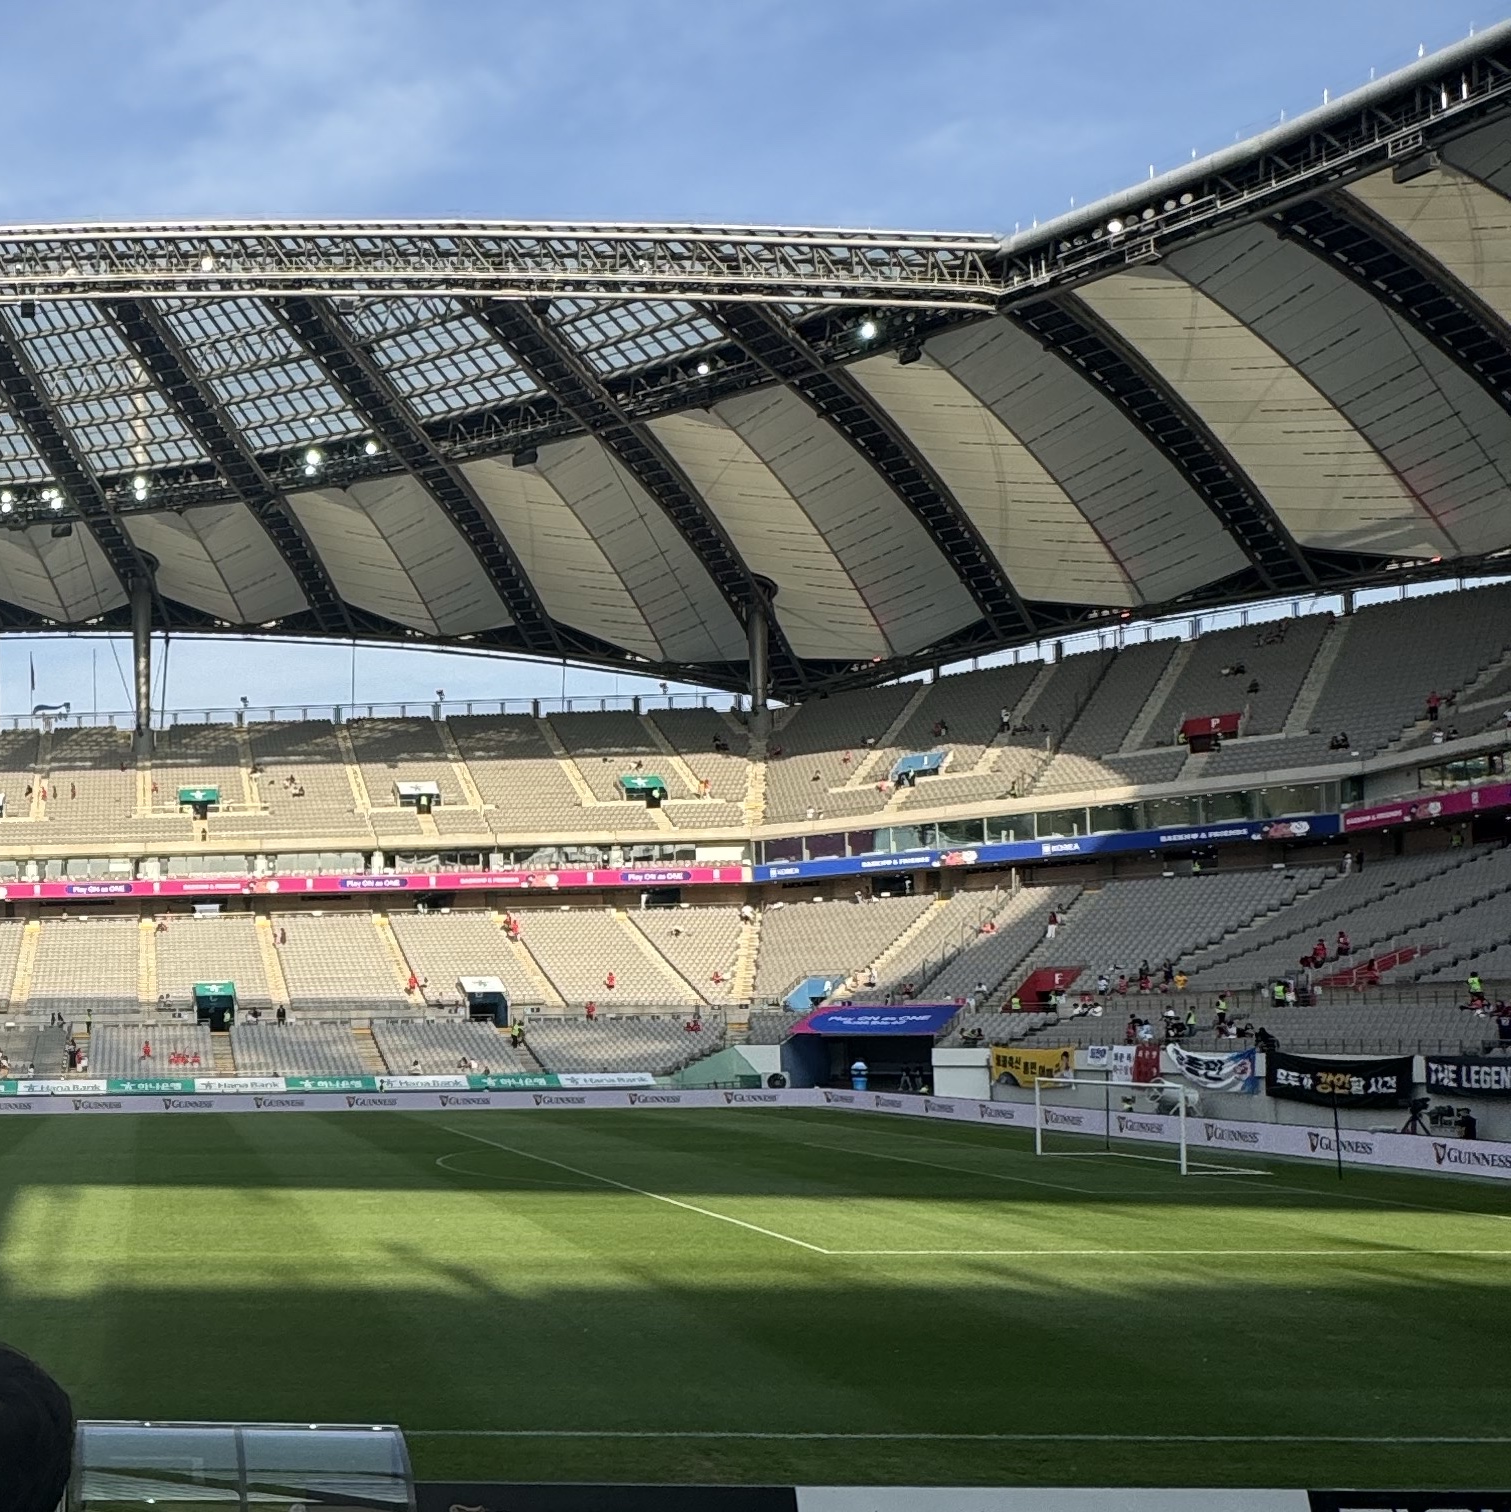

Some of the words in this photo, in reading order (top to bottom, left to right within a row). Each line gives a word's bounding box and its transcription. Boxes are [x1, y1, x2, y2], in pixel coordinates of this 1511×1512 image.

[1054, 973, 1063, 984] F
[1429, 1062, 1458, 1087] THE
[218, 1081, 249, 1090] Hana
[251, 1081, 279, 1089] Bank
[433, 1079, 462, 1088] Bank
[1276, 1068, 1313, 1090] 모두가
[1315, 1071, 1365, 1095] 강인할
[1367, 1075, 1397, 1094] 사건
[355, 1098, 398, 1107] GUINNESS
[448, 1097, 491, 1106] GUINNESS
[543, 1096, 586, 1105] GUINNESS
[638, 1095, 681, 1104] GUINNESS
[733, 1094, 778, 1103] GUINNESS
[82, 1101, 122, 1110] GUINNESS
[172, 1100, 215, 1109] GUINNESS
[1213, 1127, 1260, 1143] GUINNESS
[1320, 1136, 1373, 1155] GUINNESS
[1447, 1146, 1511, 1169] GUINNESS
